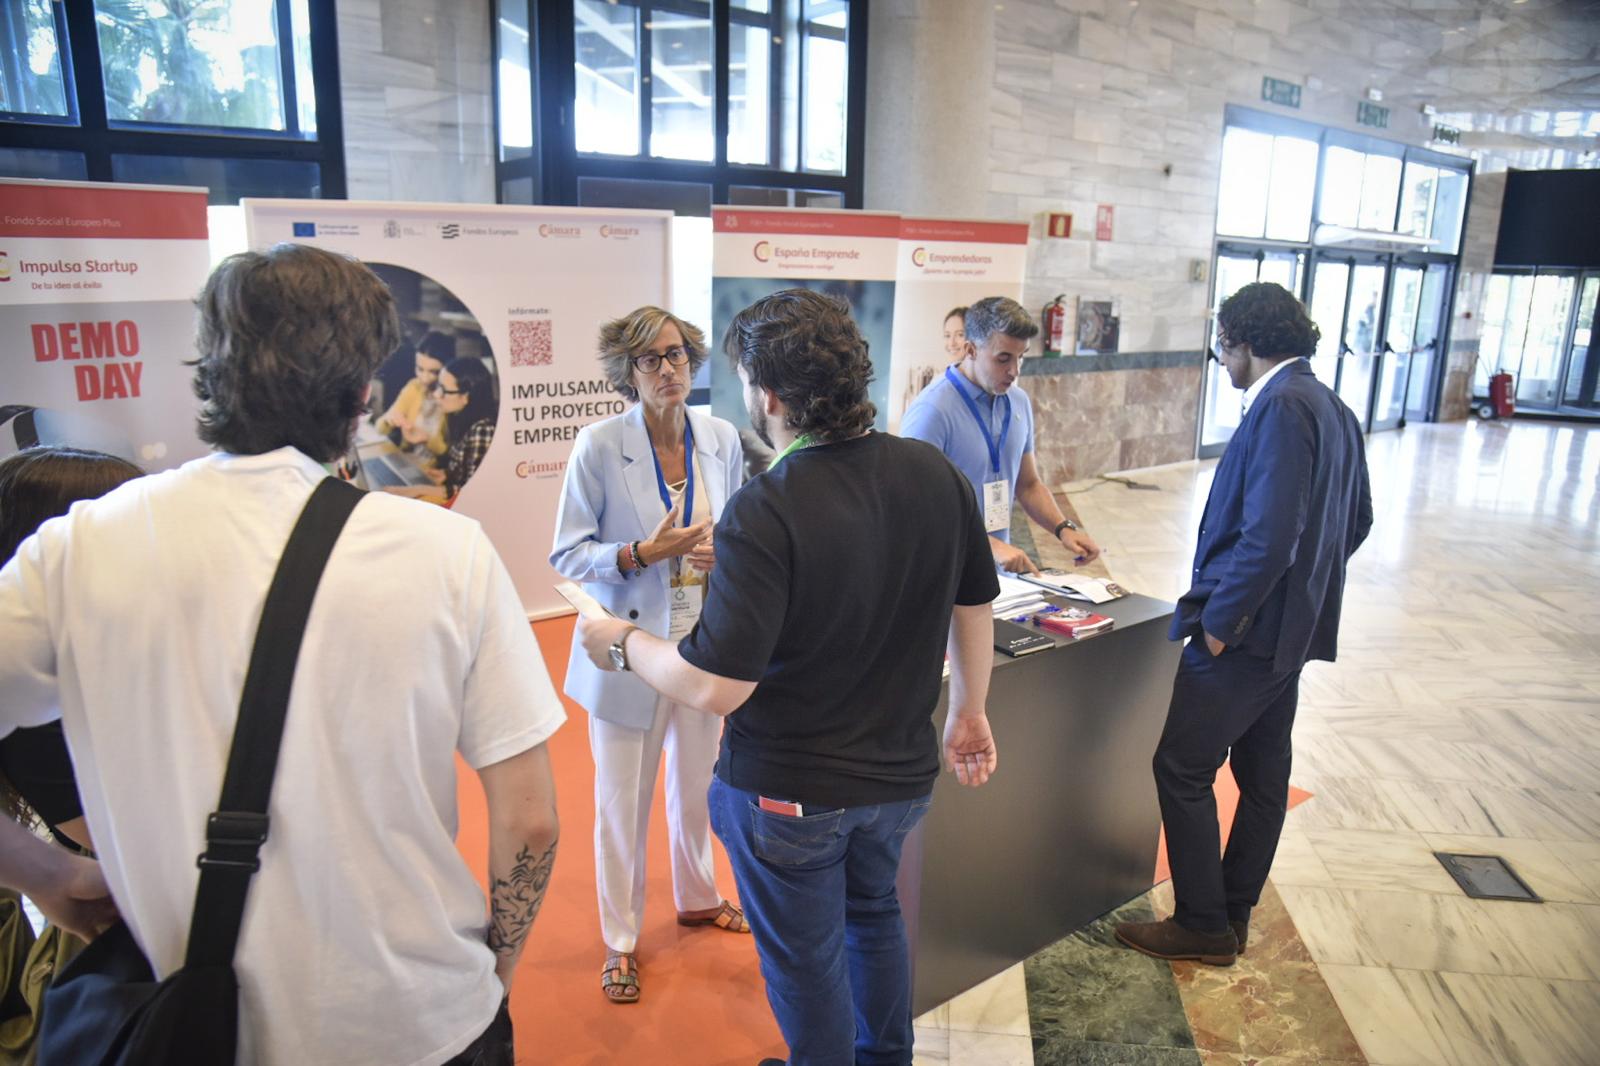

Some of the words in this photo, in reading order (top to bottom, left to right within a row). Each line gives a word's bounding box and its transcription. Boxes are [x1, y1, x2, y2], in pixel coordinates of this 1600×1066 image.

[5, 215, 34, 226] Fondo
[37, 216, 64, 227] Social
[65, 217, 101, 229] Europeo
[774, 247, 810, 260] España
[812, 248, 860, 261] Emprende
[19, 259, 82, 277] Impulsa
[84, 259, 139, 277] Startup
[31, 319, 140, 362] DEMO
[74, 361, 144, 402] DAY
[511, 379, 616, 401] IMPULSAMO
[511, 406, 536, 423] TU
[540, 400, 625, 421] PROYECTO
[515, 459, 567, 480] Cámar
